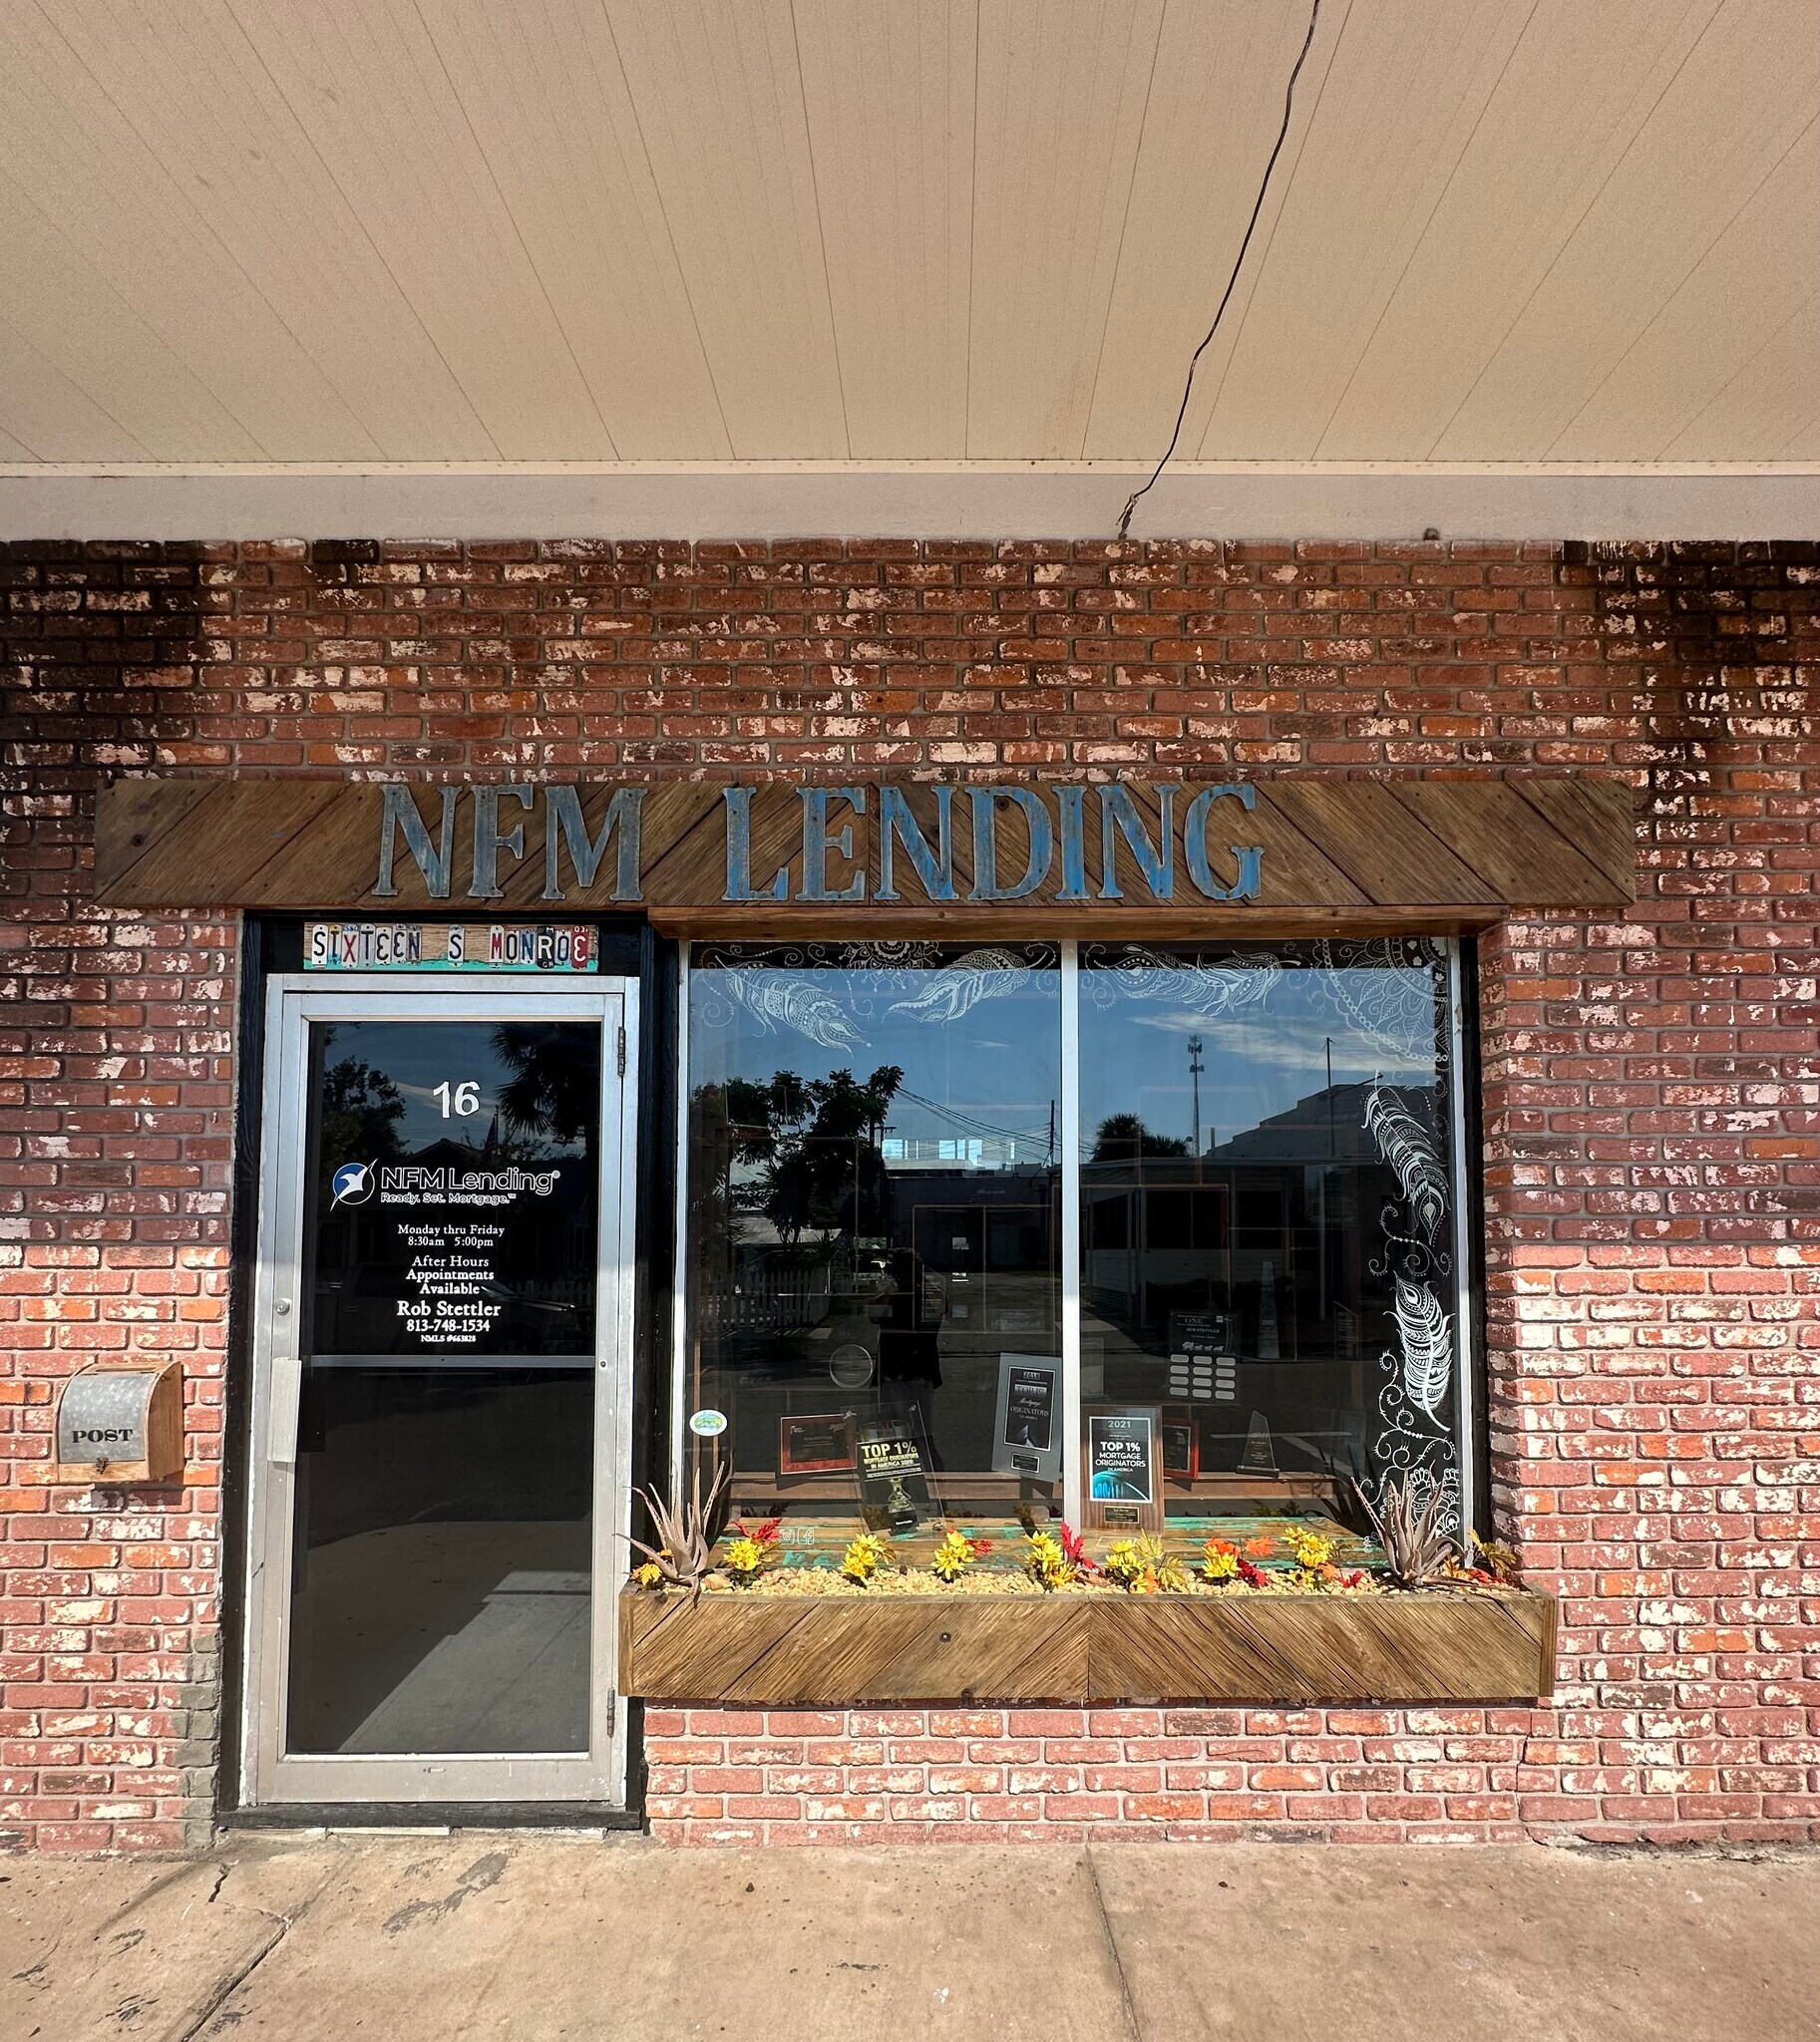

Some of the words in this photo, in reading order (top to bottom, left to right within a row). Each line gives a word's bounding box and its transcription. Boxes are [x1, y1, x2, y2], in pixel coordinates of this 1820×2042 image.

[371, 783, 648, 901] NFM
[721, 784, 1266, 900] LENDING
[313, 930, 420, 962] SIXTEEN
[449, 933, 462, 960] S
[492, 933, 586, 962] MONROE
[433, 1081, 481, 1119] 16
[381, 1167, 445, 1190] NFM
[380, 1191, 421, 1205] Ready.
[423, 1192, 447, 1203] Set.
[398, 1224, 441, 1236] Monday
[443, 1224, 466, 1234] thru
[470, 1224, 505, 1237] Friday
[408, 1236, 445, 1246] 8:30am
[454, 1236, 494, 1248] 5:00pm
[412, 1255, 447, 1266] After
[450, 1255, 490, 1266] Hours
[406, 1268, 495, 1283] Appointments
[419, 1282, 480, 1294] Available
[397, 1300, 432, 1316] Rob
[436, 1300, 502, 1316] Stettler
[407, 1319, 490, 1332] 813-748-1534
[72, 1429, 133, 1443] POST
[861, 1443, 891, 1458] TOP
[894, 1441, 917, 1455] 1%
[1100, 1441, 1124, 1451] TOP
[1125, 1442, 1141, 1452] 1%
[1095, 1459, 1147, 1468] ORIGINATORS
